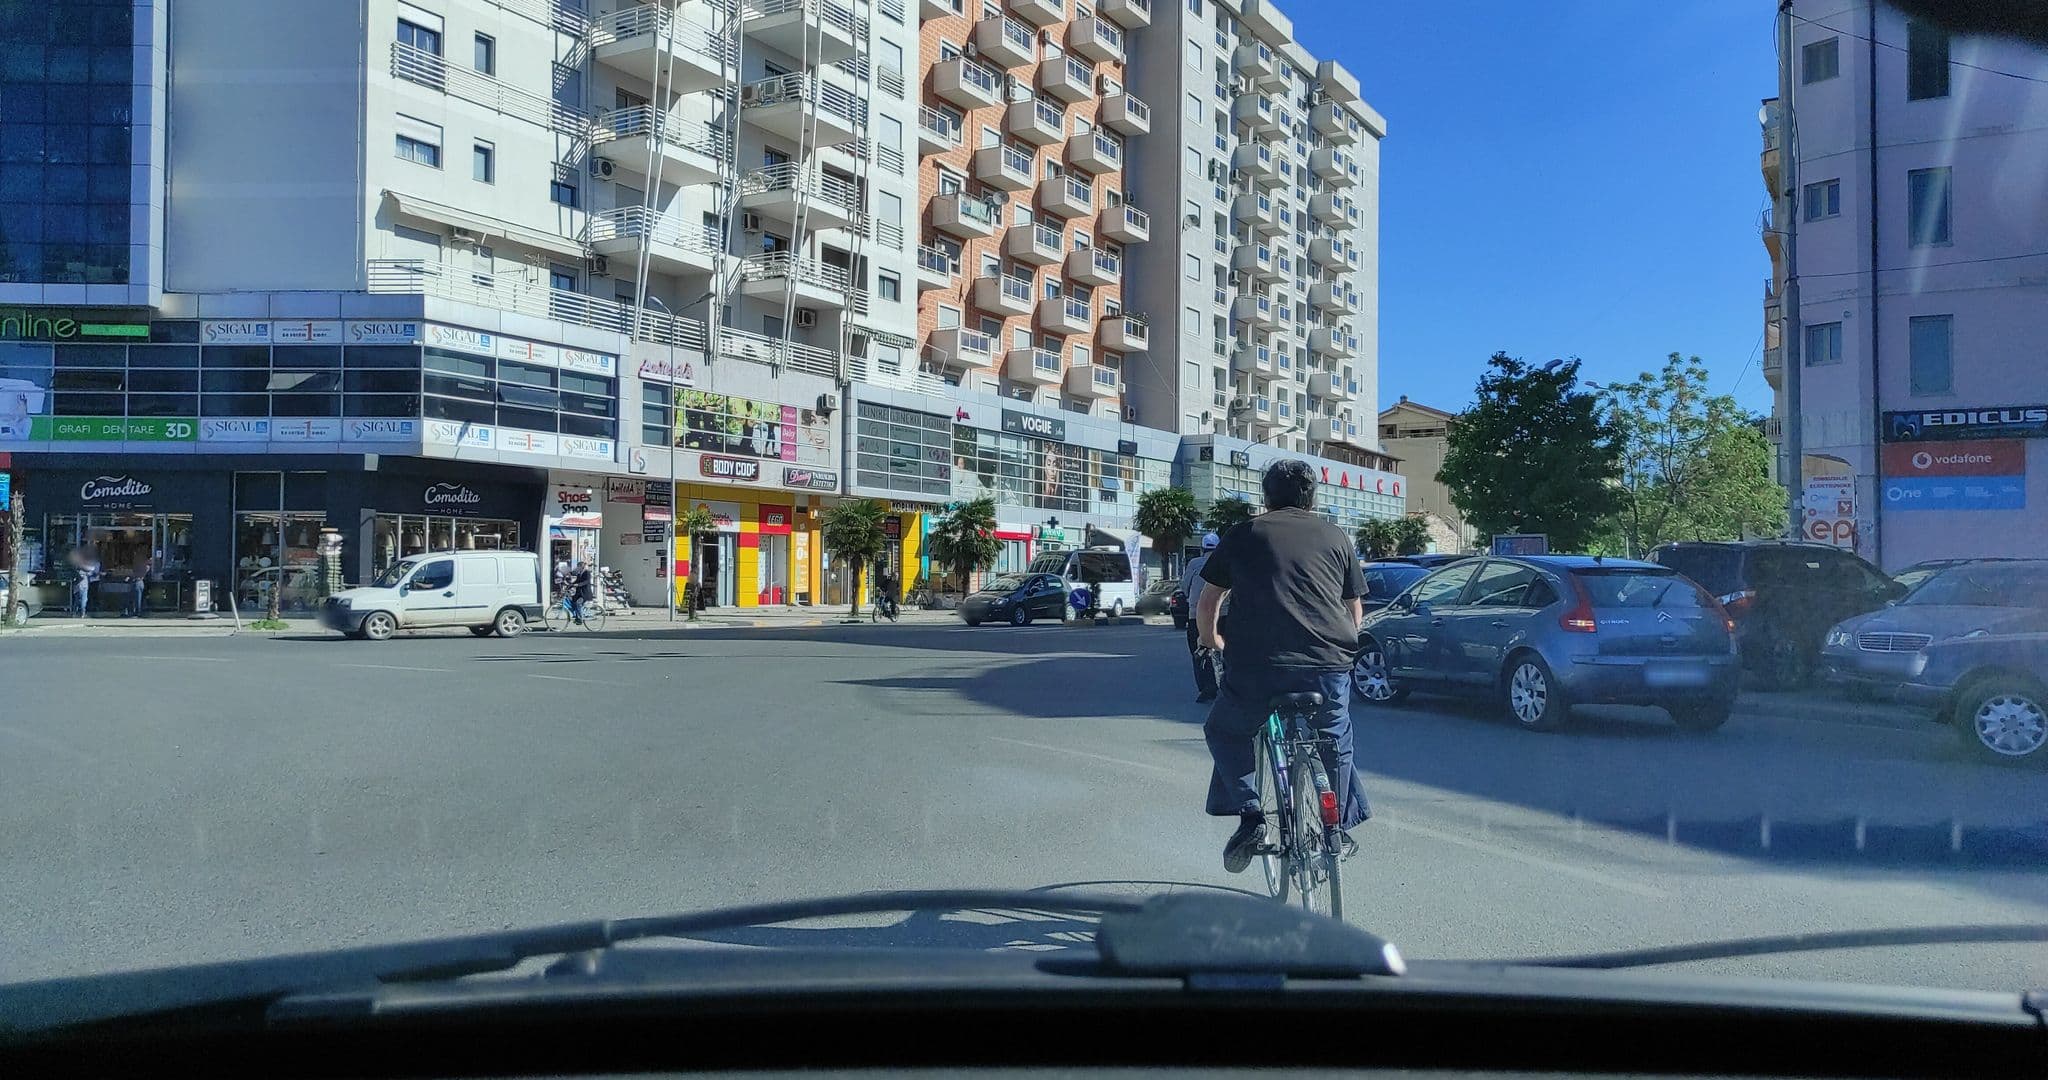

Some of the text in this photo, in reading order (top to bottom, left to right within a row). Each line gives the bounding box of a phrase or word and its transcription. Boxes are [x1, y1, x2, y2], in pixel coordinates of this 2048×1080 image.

[217, 323, 256, 335] SIGAL
[363, 323, 402, 335] SIGAL
[443, 328, 480, 345] SIGAL
[573, 351, 601, 365] SIGAL
[59, 424, 91, 434] GRAFI
[165, 423, 192, 438] 3D
[215, 421, 255, 432] SIGAL
[362, 421, 400, 432] SIGAL
[441, 424, 479, 439] SIGAL
[1021, 416, 1052, 434] VOGUE
[572, 439, 600, 452] SIGAL
[1935, 453, 1992, 464] vodafone
[713, 459, 756, 477] BODY CODE
[81, 477, 152, 500] Comodita
[424, 486, 480, 504] Comodita
[1887, 486, 1922, 501] One
[558, 491, 592, 504] Shoes
[103, 502, 133, 510] HOME
[562, 504, 589, 516] Shop
[767, 513, 785, 525] LEGO
